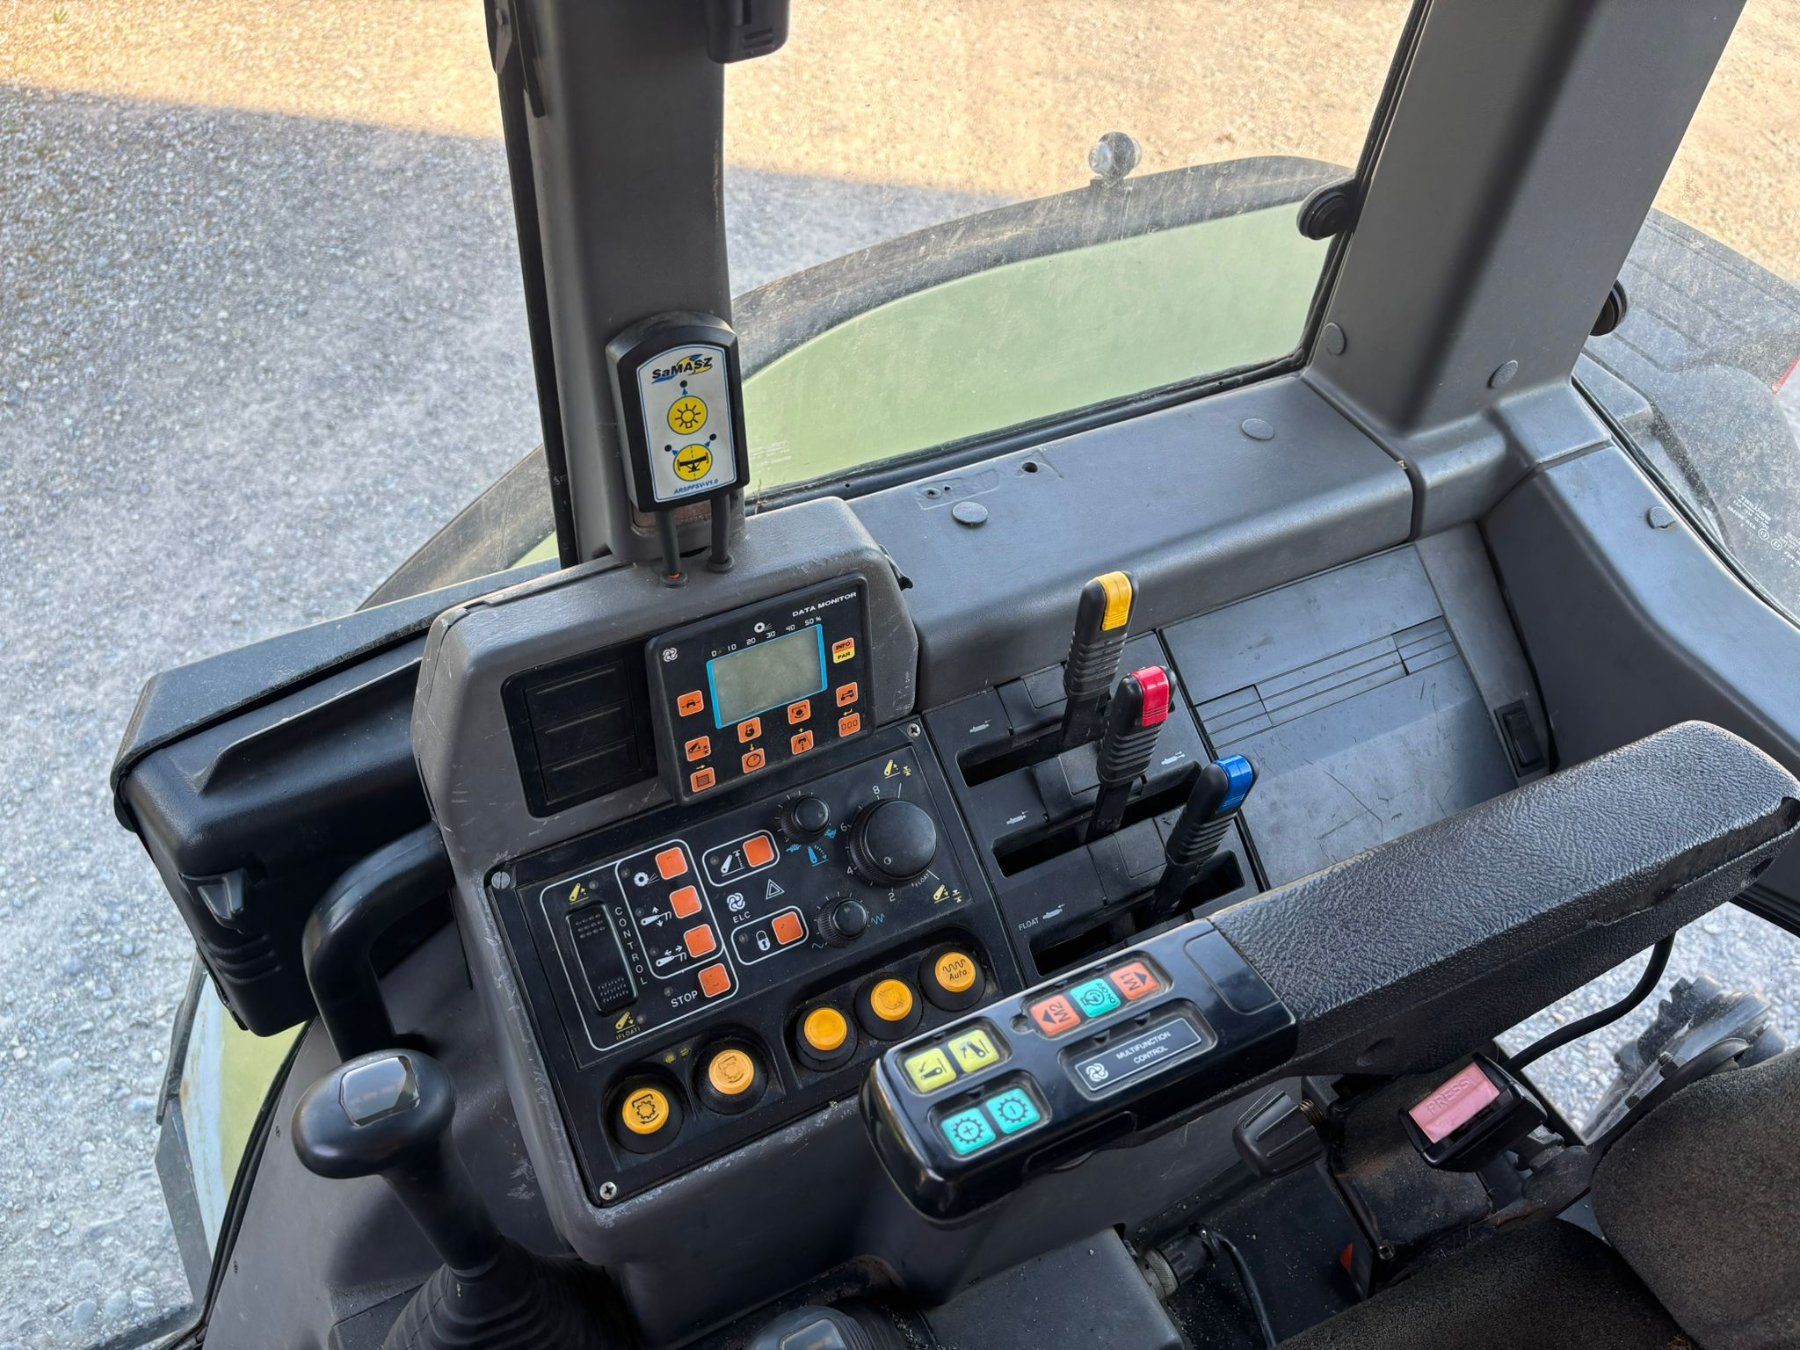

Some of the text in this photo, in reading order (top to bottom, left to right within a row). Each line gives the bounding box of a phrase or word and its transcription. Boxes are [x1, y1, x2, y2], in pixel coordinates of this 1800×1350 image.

[652, 357, 713, 379] SaMASZ
[792, 591, 857, 617] DATA MONITOR
[727, 643, 737, 651] 10
[746, 637, 756, 646] 20
[766, 630, 776, 638] 30
[785, 624, 796, 632] 40
[804, 617, 815, 626] 50
[872, 785, 880, 795] 8
[840, 823, 848, 832] 6
[846, 865, 854, 875] 4
[888, 892, 896, 902] 2
[732, 911, 751, 924] ELC
[1018, 917, 1039, 931] FLOAT
[614, 906, 647, 985] CONTROL
[949, 968, 968, 982] Auto
[1120, 973, 1140, 992] M1
[670, 990, 699, 1008] STOP
[1049, 1001, 1072, 1023] M2
[1116, 1031, 1172, 1060] MULTIFUNCTION
[1133, 1045, 1168, 1064] CONTROL
[1425, 1077, 1474, 1116] PRESS
